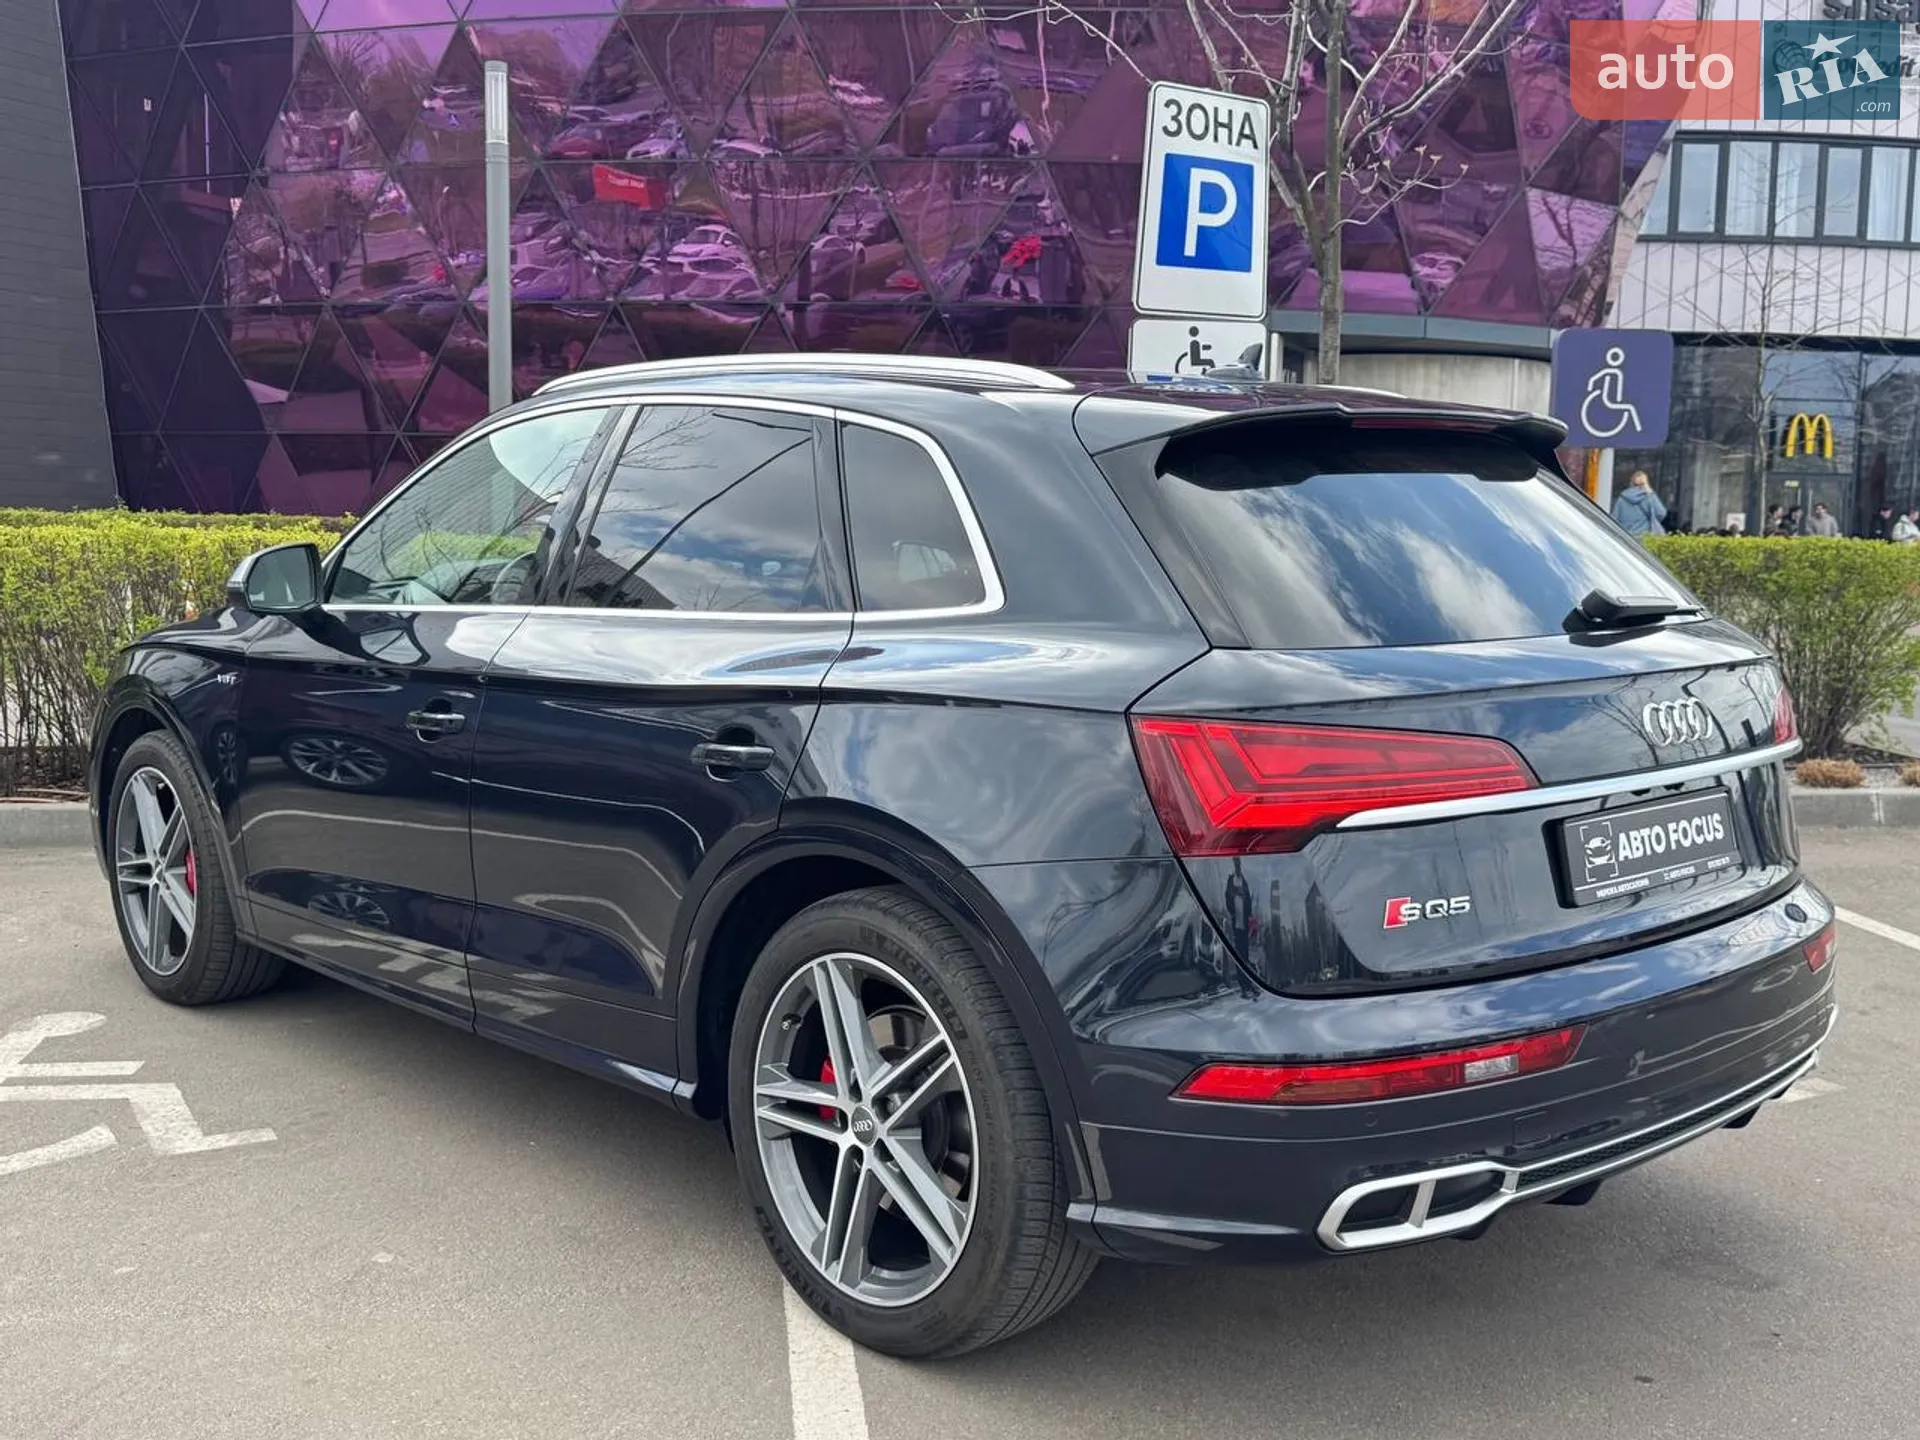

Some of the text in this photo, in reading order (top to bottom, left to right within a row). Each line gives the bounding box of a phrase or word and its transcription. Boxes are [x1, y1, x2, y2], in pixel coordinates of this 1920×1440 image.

[1162, 99, 1259, 150] ЗОНА
[1183, 166, 1238, 258] P
[1618, 813, 1724, 862] АВТО FOCUS
[1396, 896, 1471, 922] SQ5
